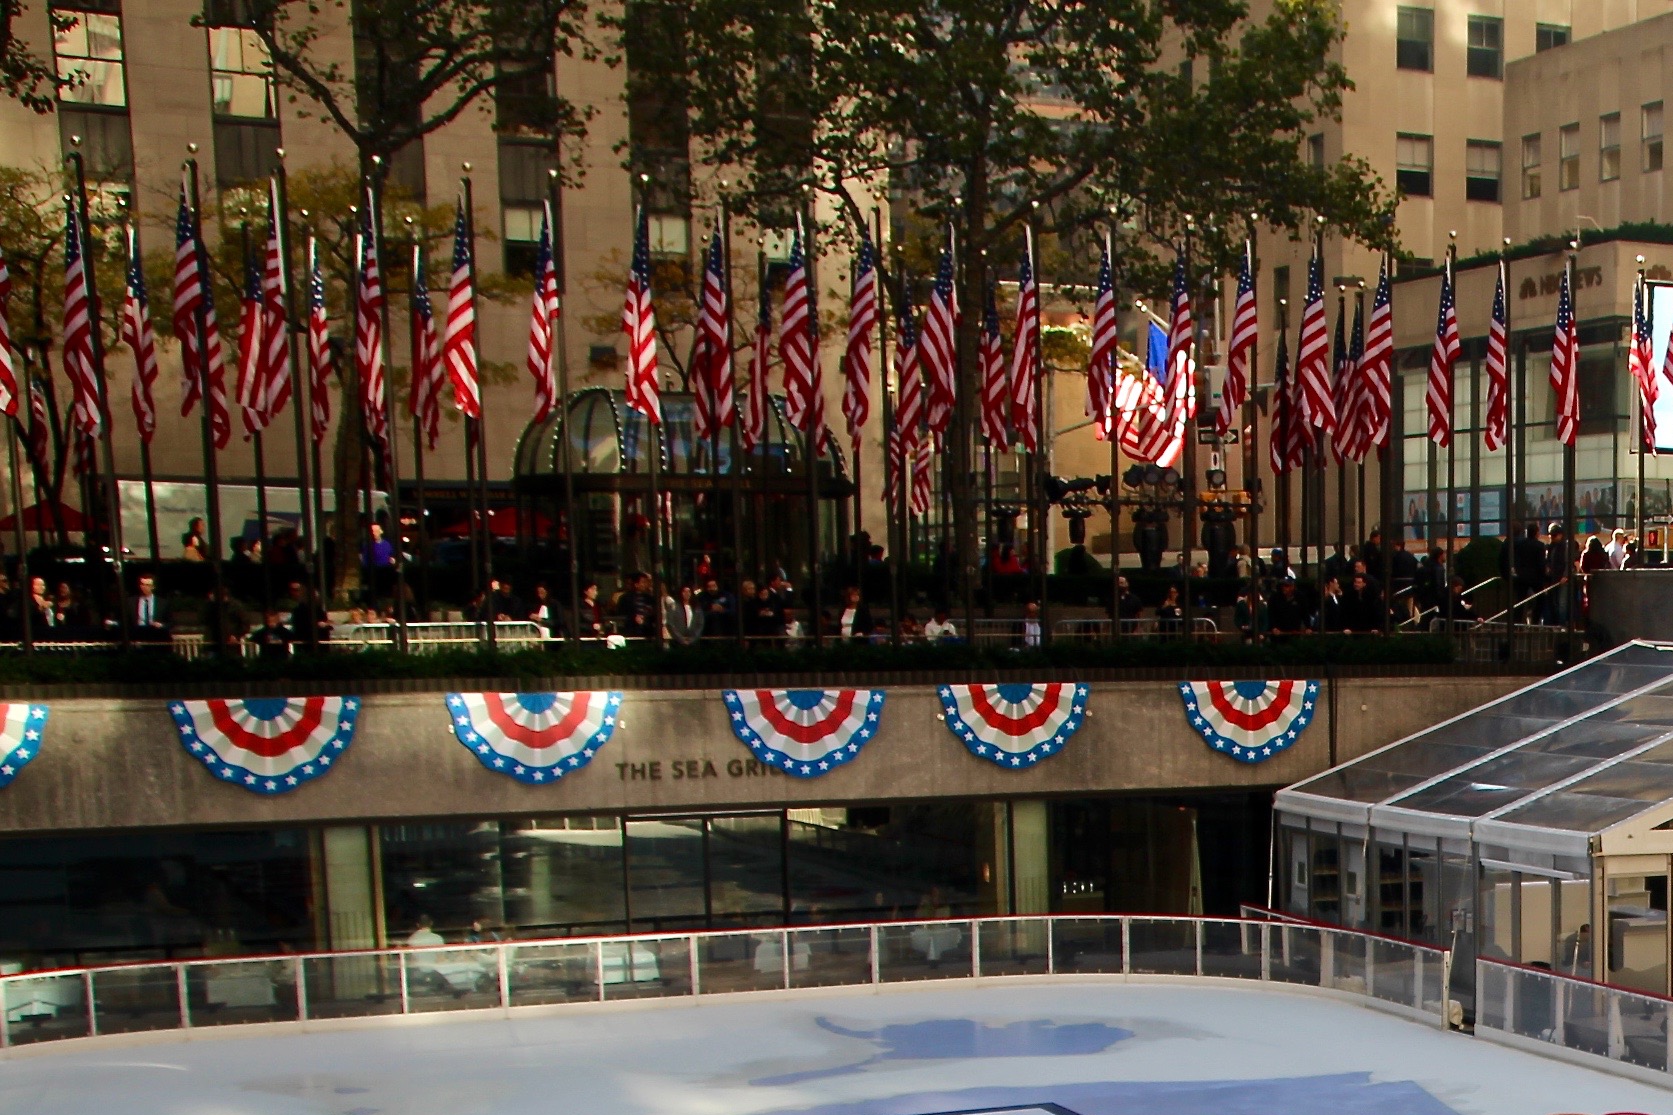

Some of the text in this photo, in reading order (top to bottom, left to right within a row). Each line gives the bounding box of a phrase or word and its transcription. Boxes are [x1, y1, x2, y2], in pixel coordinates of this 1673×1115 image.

[1575, 265, 1603, 290] EWS
[615, 758, 784, 781] THE SEA GRI
